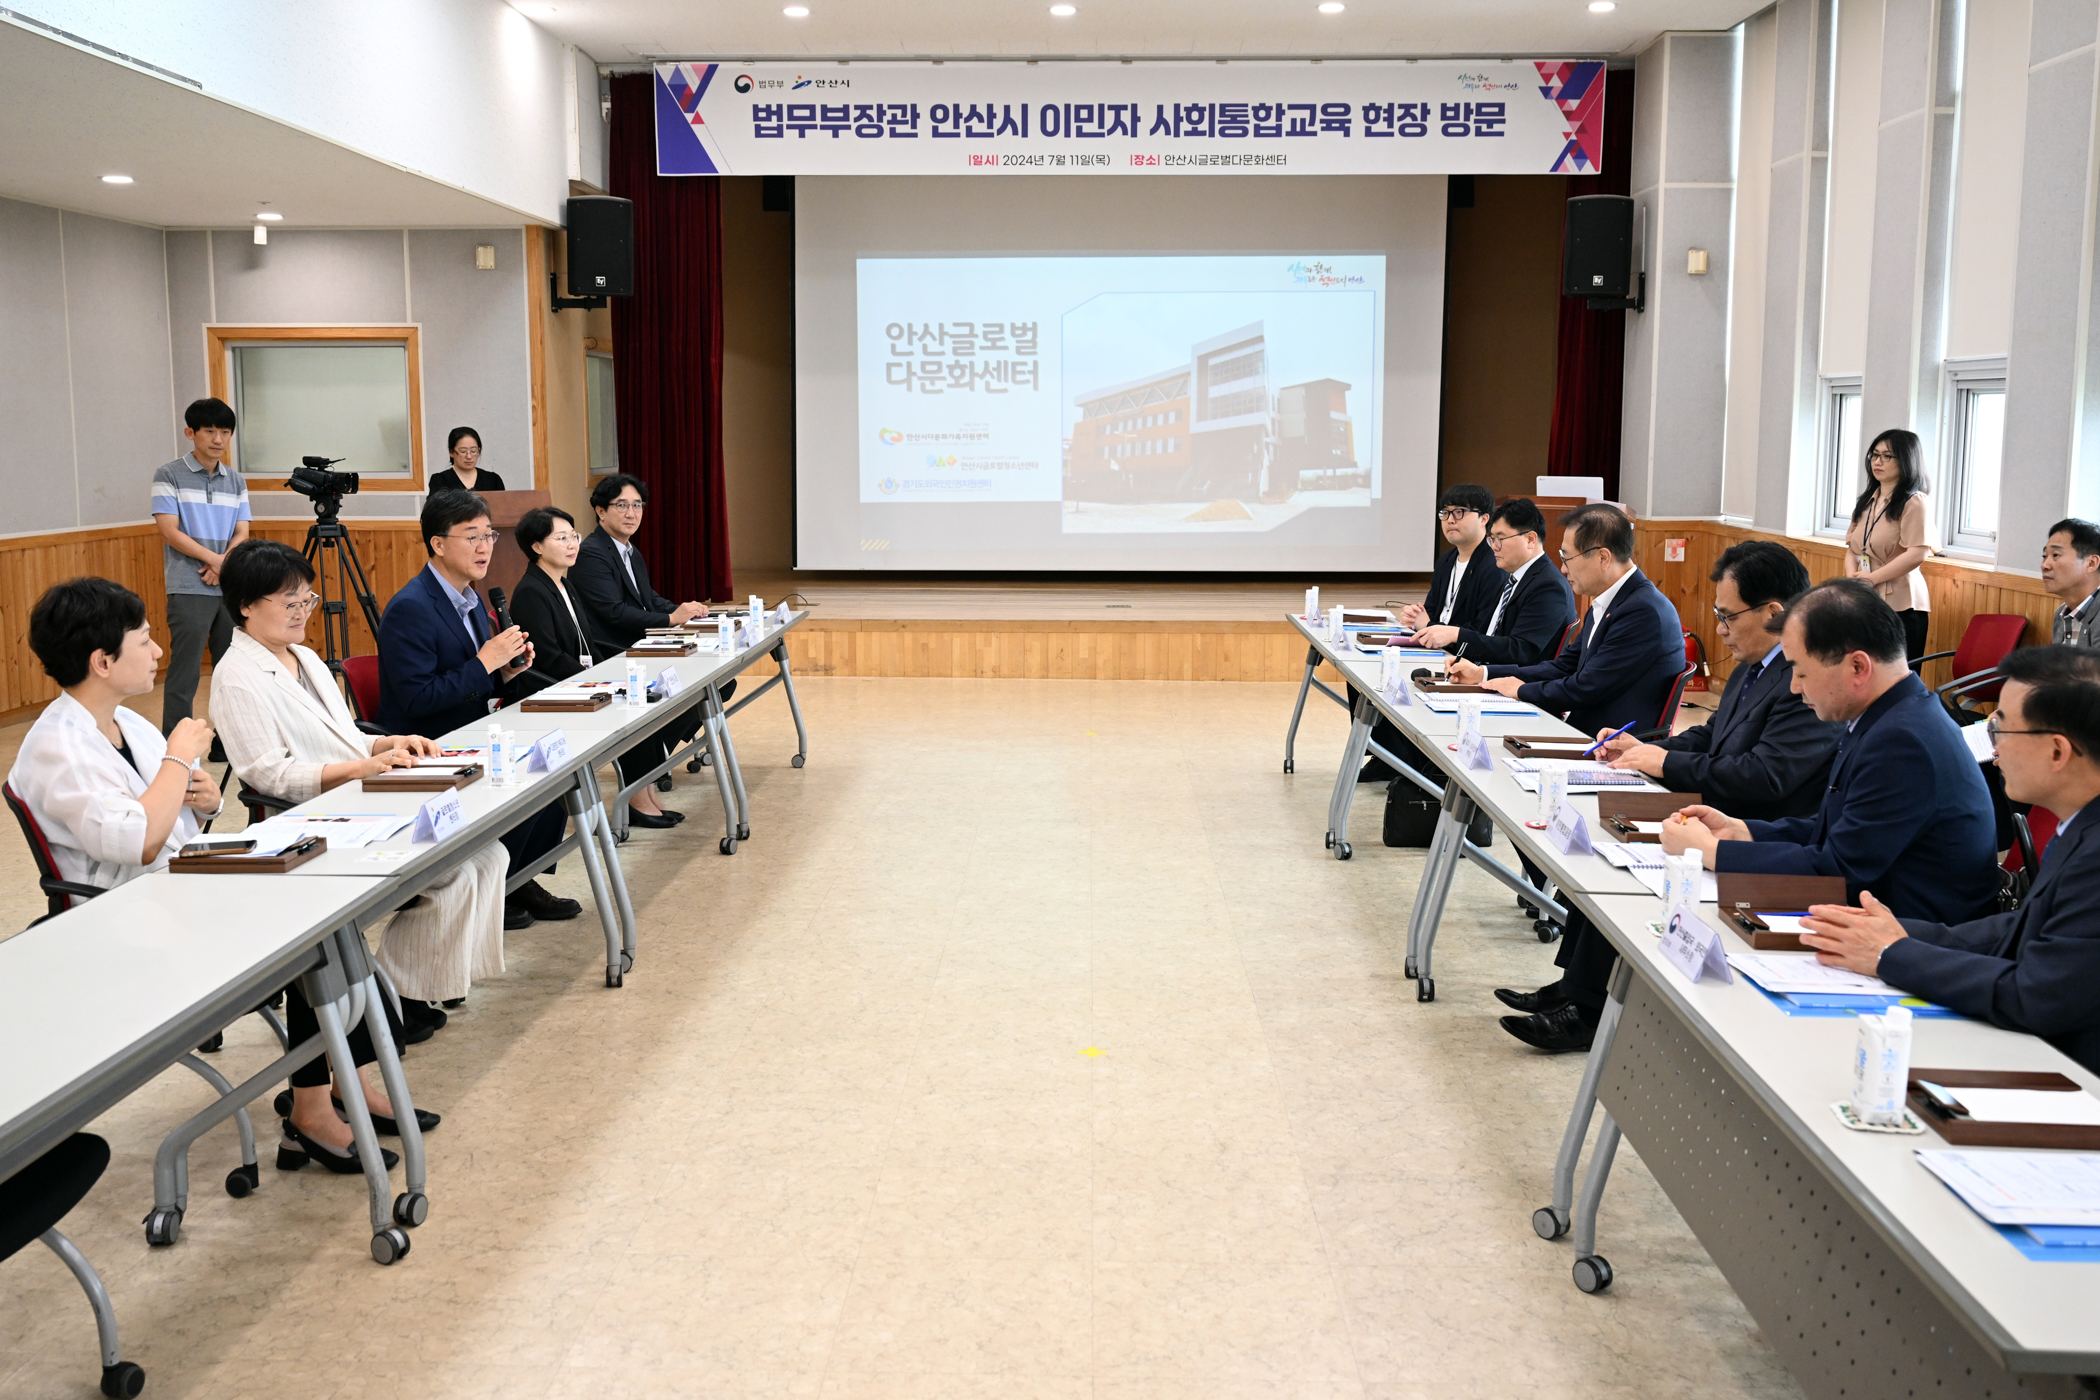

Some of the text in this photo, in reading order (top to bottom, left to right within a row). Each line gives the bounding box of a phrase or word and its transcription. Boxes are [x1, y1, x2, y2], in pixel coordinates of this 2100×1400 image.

[758, 80, 785, 89] 법무부
[815, 79, 850, 88] 안산시
[752, 102, 1507, 138] 법무부장관 안산시 이민자 사회통합교육 현장 방문
[1002, 154, 1044, 166] 2024년
[1048, 154, 1066, 166] 7월
[1069, 154, 1111, 166] 11일(목)
[1164, 154, 1287, 166] 안산시글로벌다문화센터
[885, 321, 1039, 356] 안산글로벌
[885, 359, 1039, 394] 다문화센터
